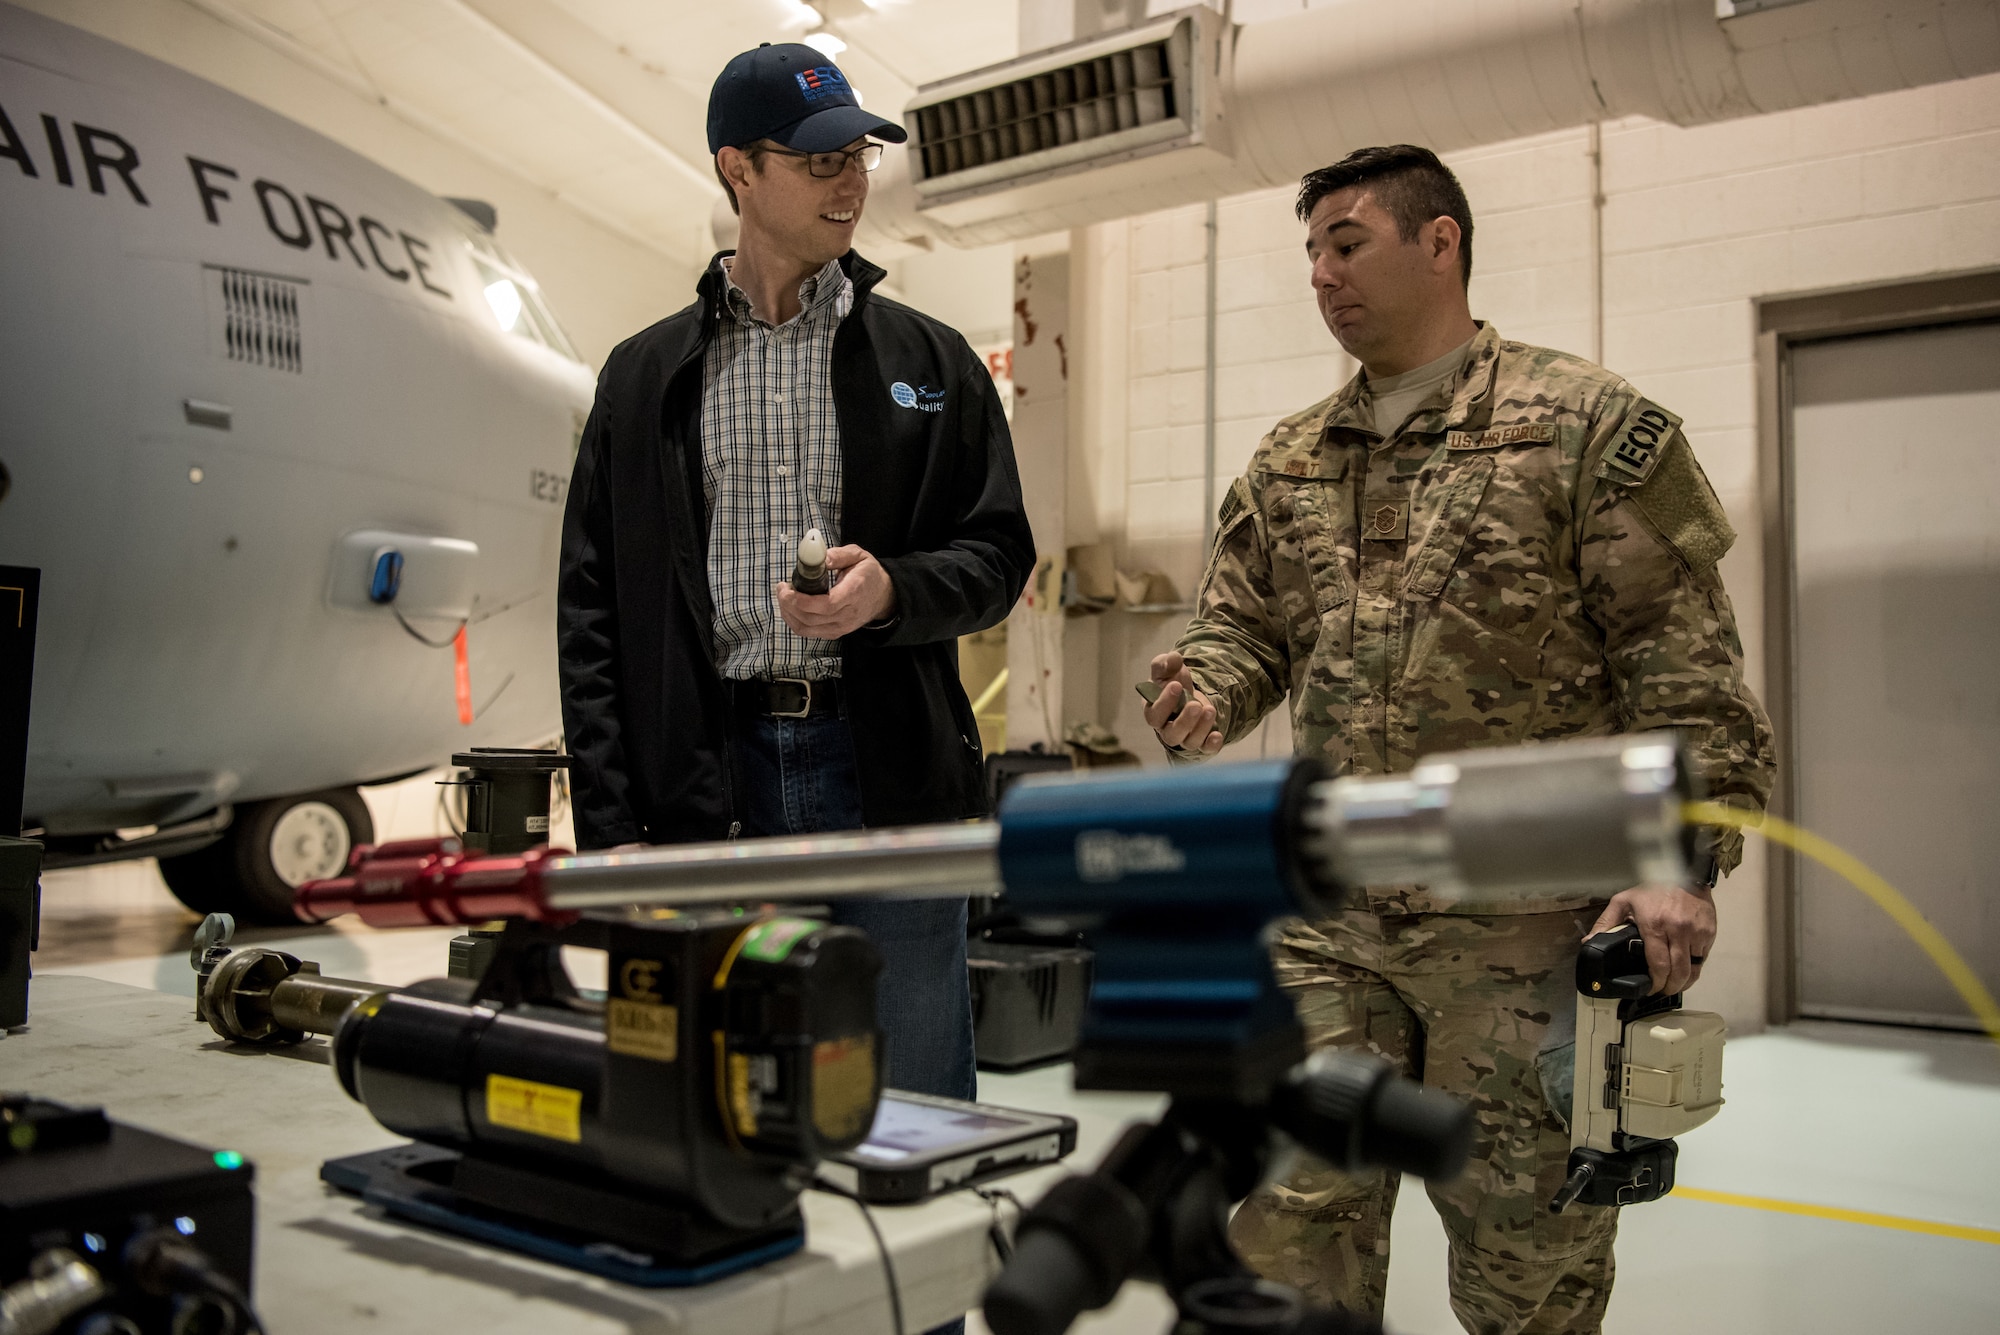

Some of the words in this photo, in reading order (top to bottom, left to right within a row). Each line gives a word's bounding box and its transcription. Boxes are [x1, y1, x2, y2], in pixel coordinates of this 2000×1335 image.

[186, 155, 453, 300] FORCE
[1451, 434, 1473, 448] U.S.
[1476, 432, 1500, 447] AIR
[1502, 425, 1550, 442] FORCE
[1614, 410, 1669, 469] EOD
